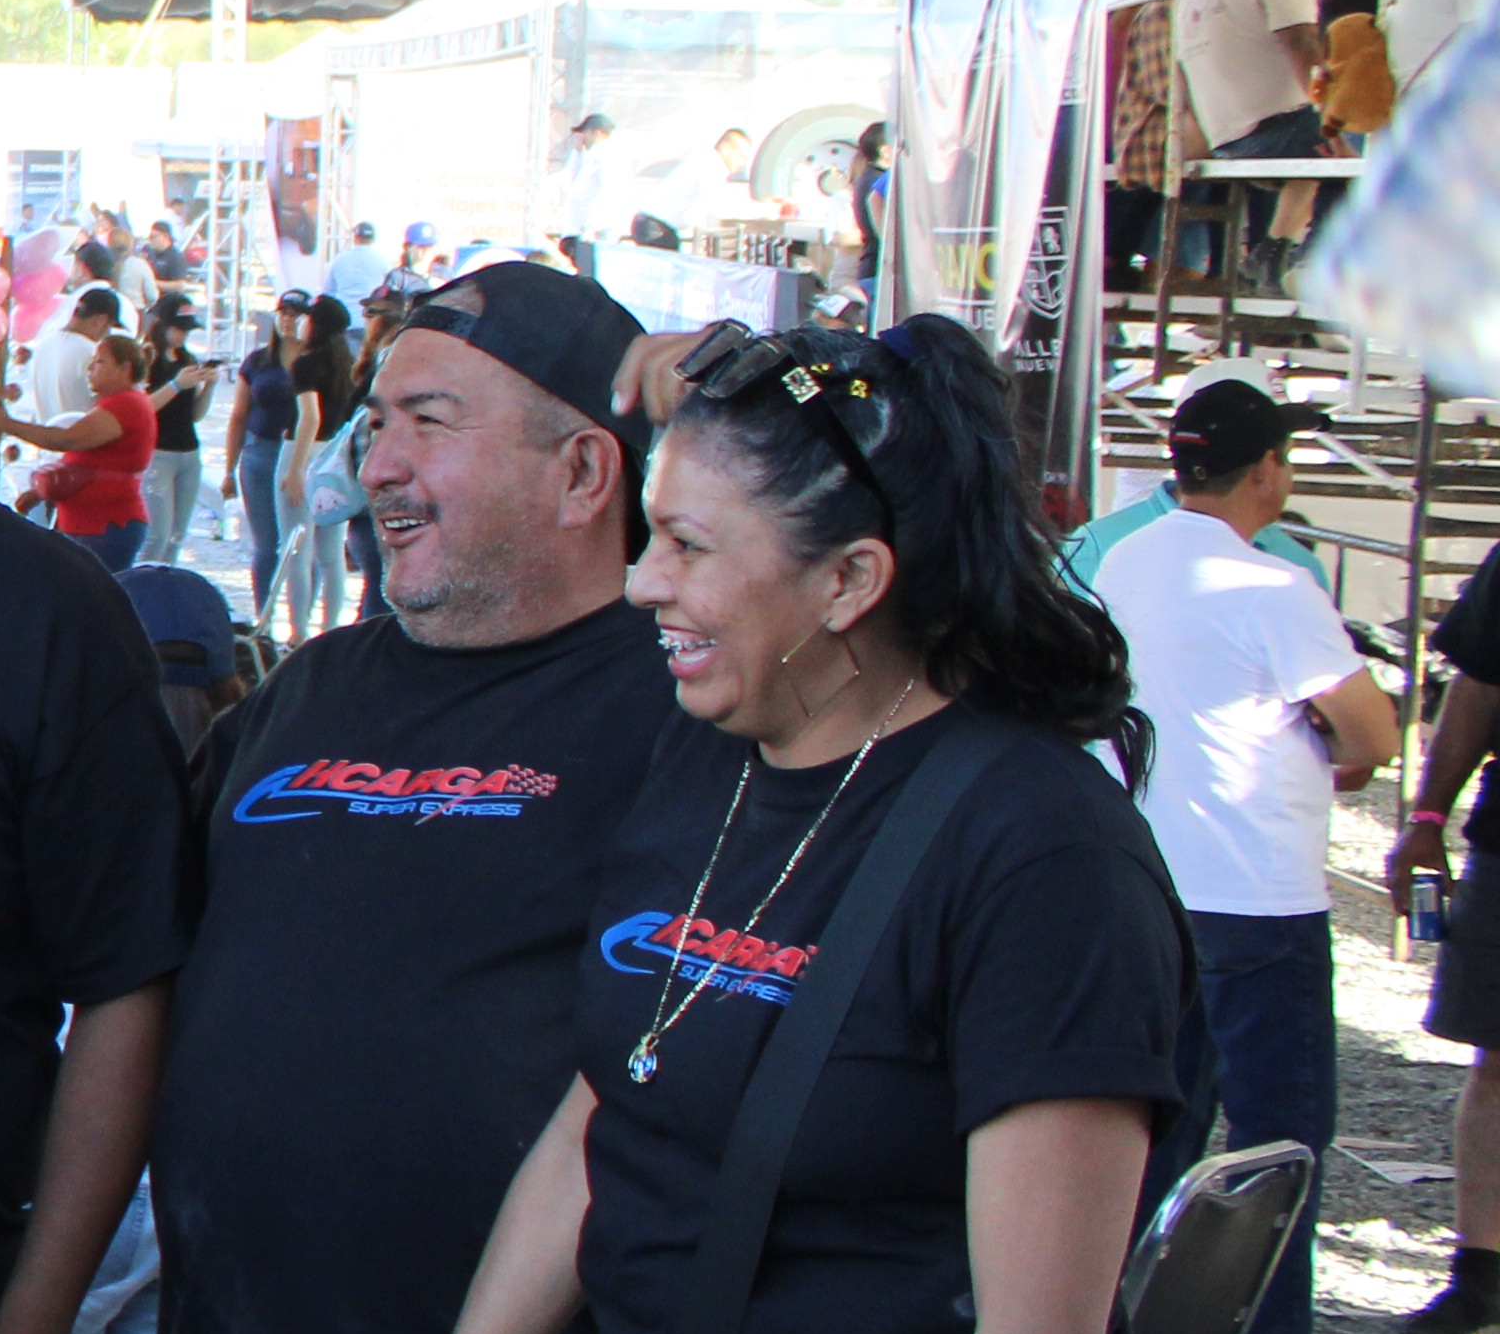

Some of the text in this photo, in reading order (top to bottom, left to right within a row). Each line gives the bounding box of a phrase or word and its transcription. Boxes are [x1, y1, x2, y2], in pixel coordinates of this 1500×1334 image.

[288, 759, 508, 798] HCARGA
[348, 800, 523, 817] SUPER EXPRESS
